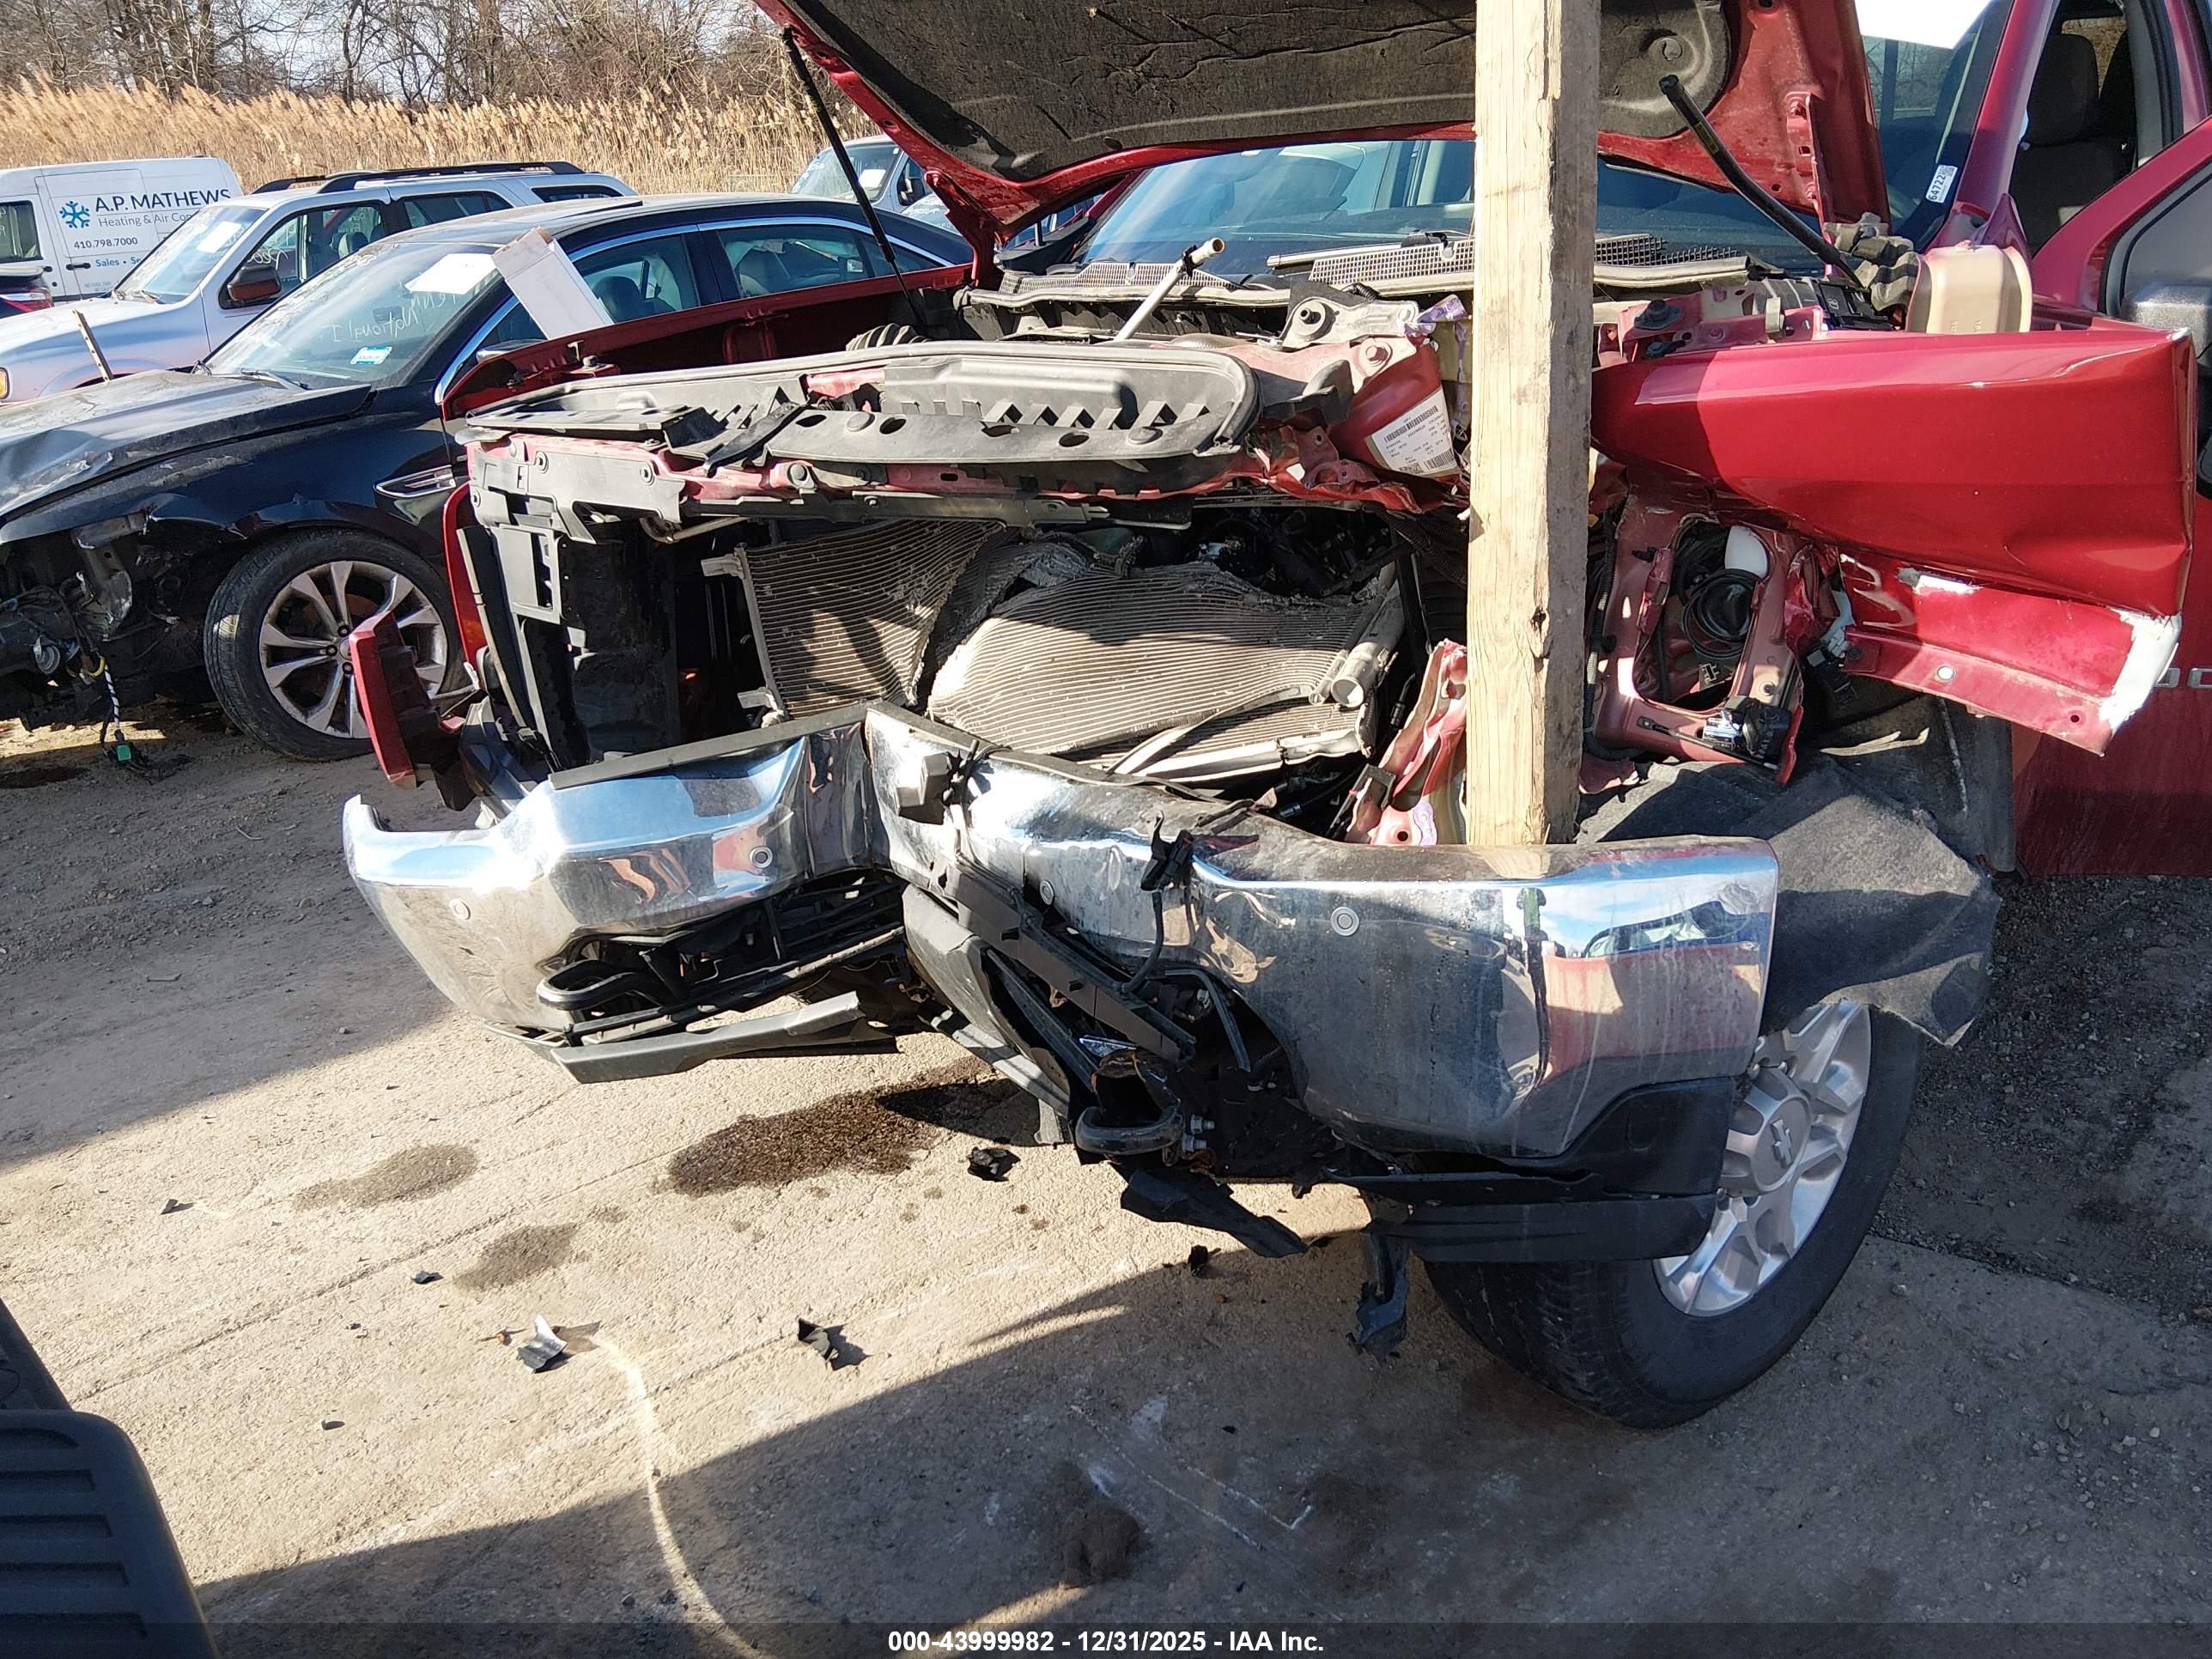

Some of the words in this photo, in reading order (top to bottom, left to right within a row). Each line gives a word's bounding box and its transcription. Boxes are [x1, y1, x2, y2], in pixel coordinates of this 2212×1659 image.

[1928, 174, 1946, 200] 64722
[95, 196, 129, 213] A.P.
[131, 188, 232, 210] MATHEWS
[98, 216, 143, 228] Heating
[143, 215, 152, 224] &
[154, 213, 169, 223] Air
[74, 237, 138, 250] 410.798.7000
[95, 258, 120, 267] Sales
